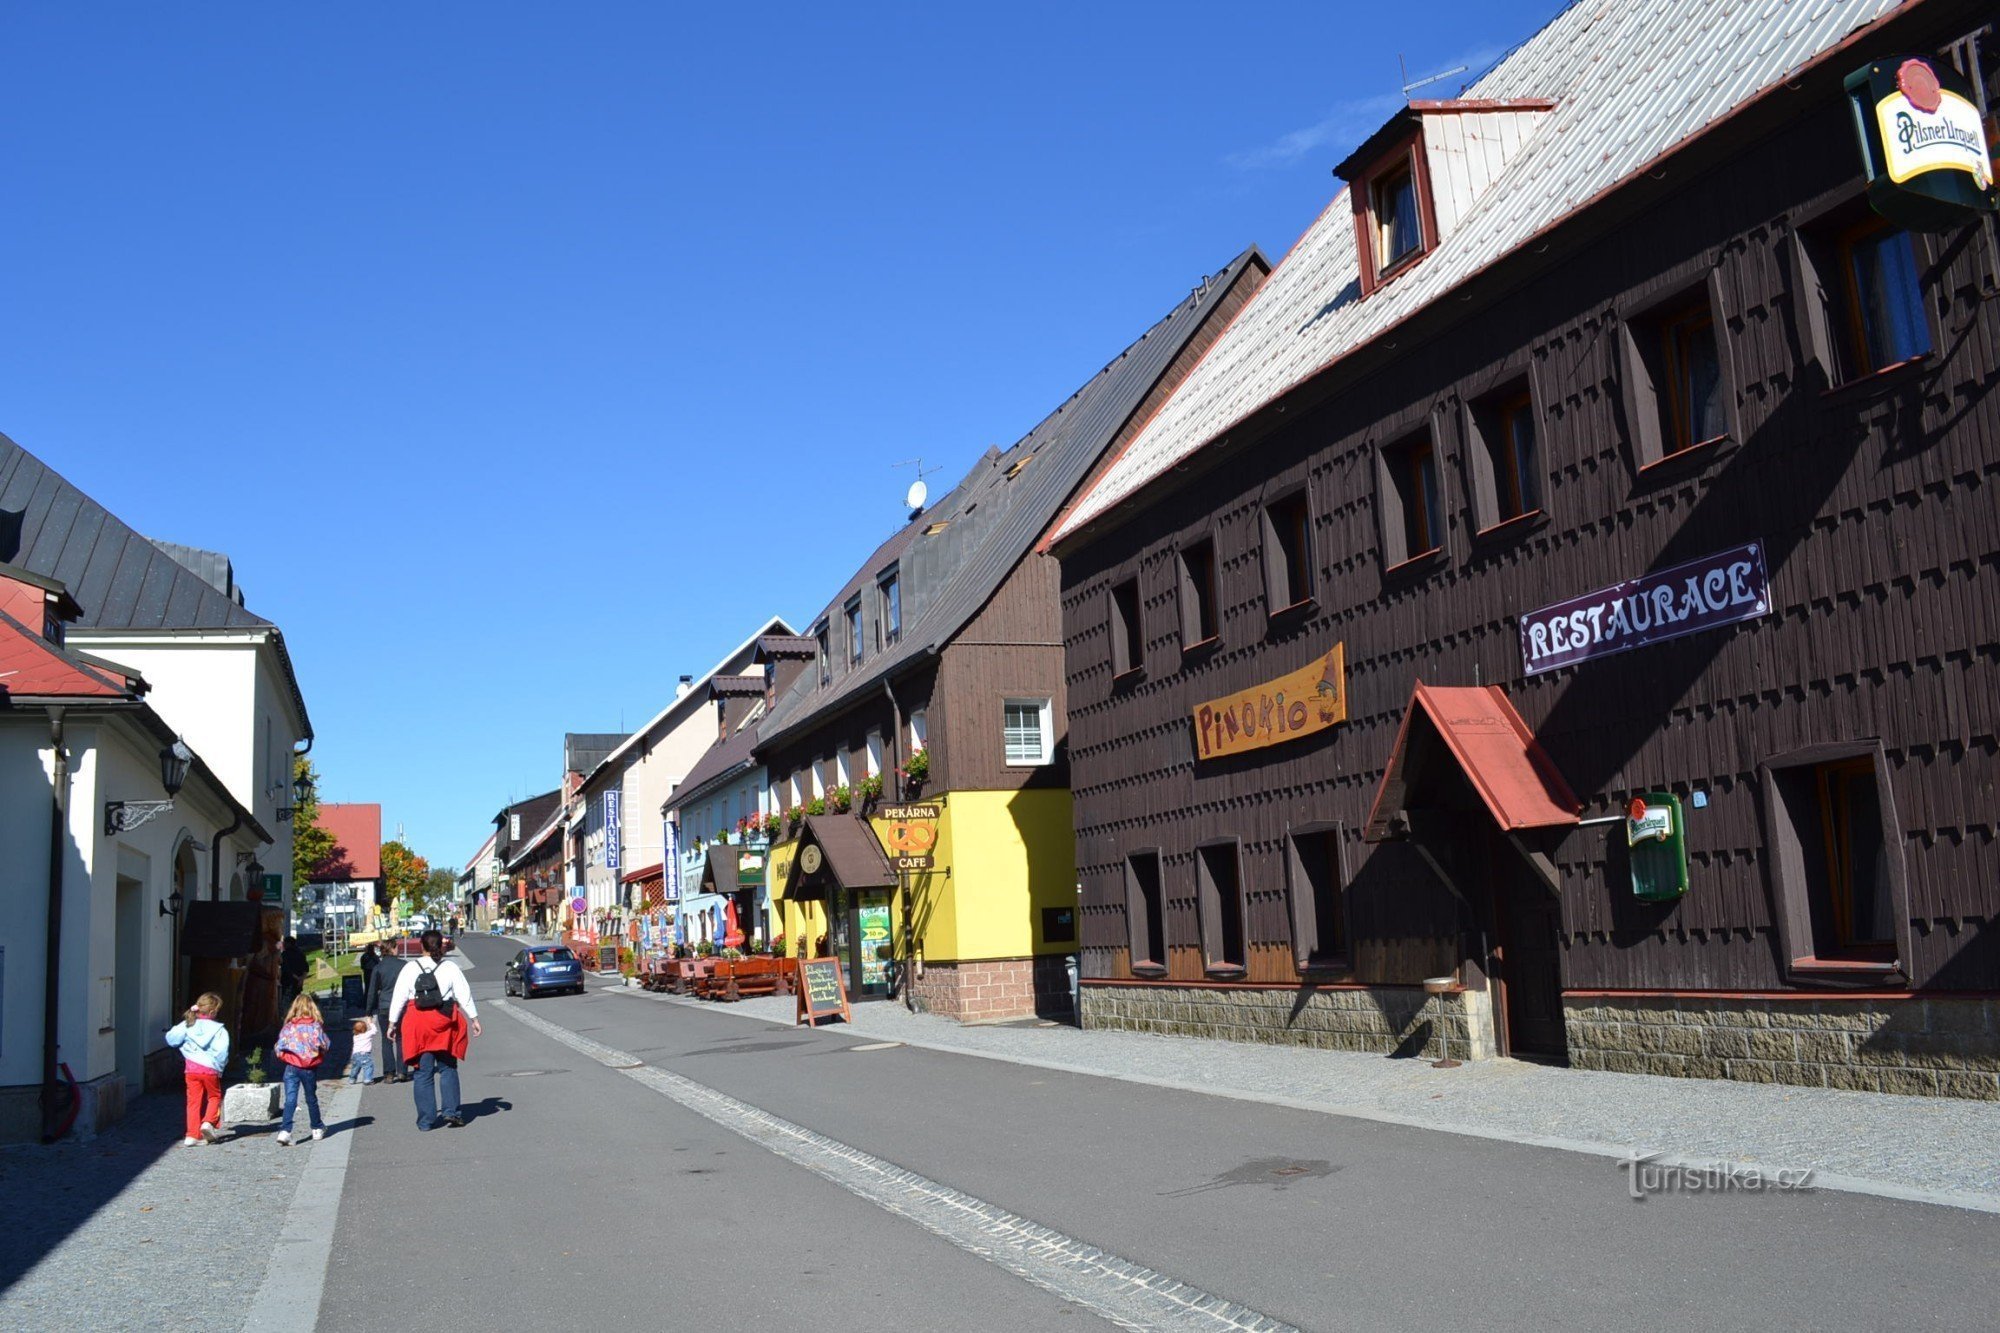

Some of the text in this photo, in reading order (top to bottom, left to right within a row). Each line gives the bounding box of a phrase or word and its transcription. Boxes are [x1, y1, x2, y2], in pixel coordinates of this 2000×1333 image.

[1896, 111, 1981, 154] Pilsner Urquell
[1528, 561, 1757, 661] RESTAURACE
[607, 793, 616, 866] RESTAURANT
[884, 805, 936, 818] PEKÁRNA
[898, 857, 926, 868] CAFE
